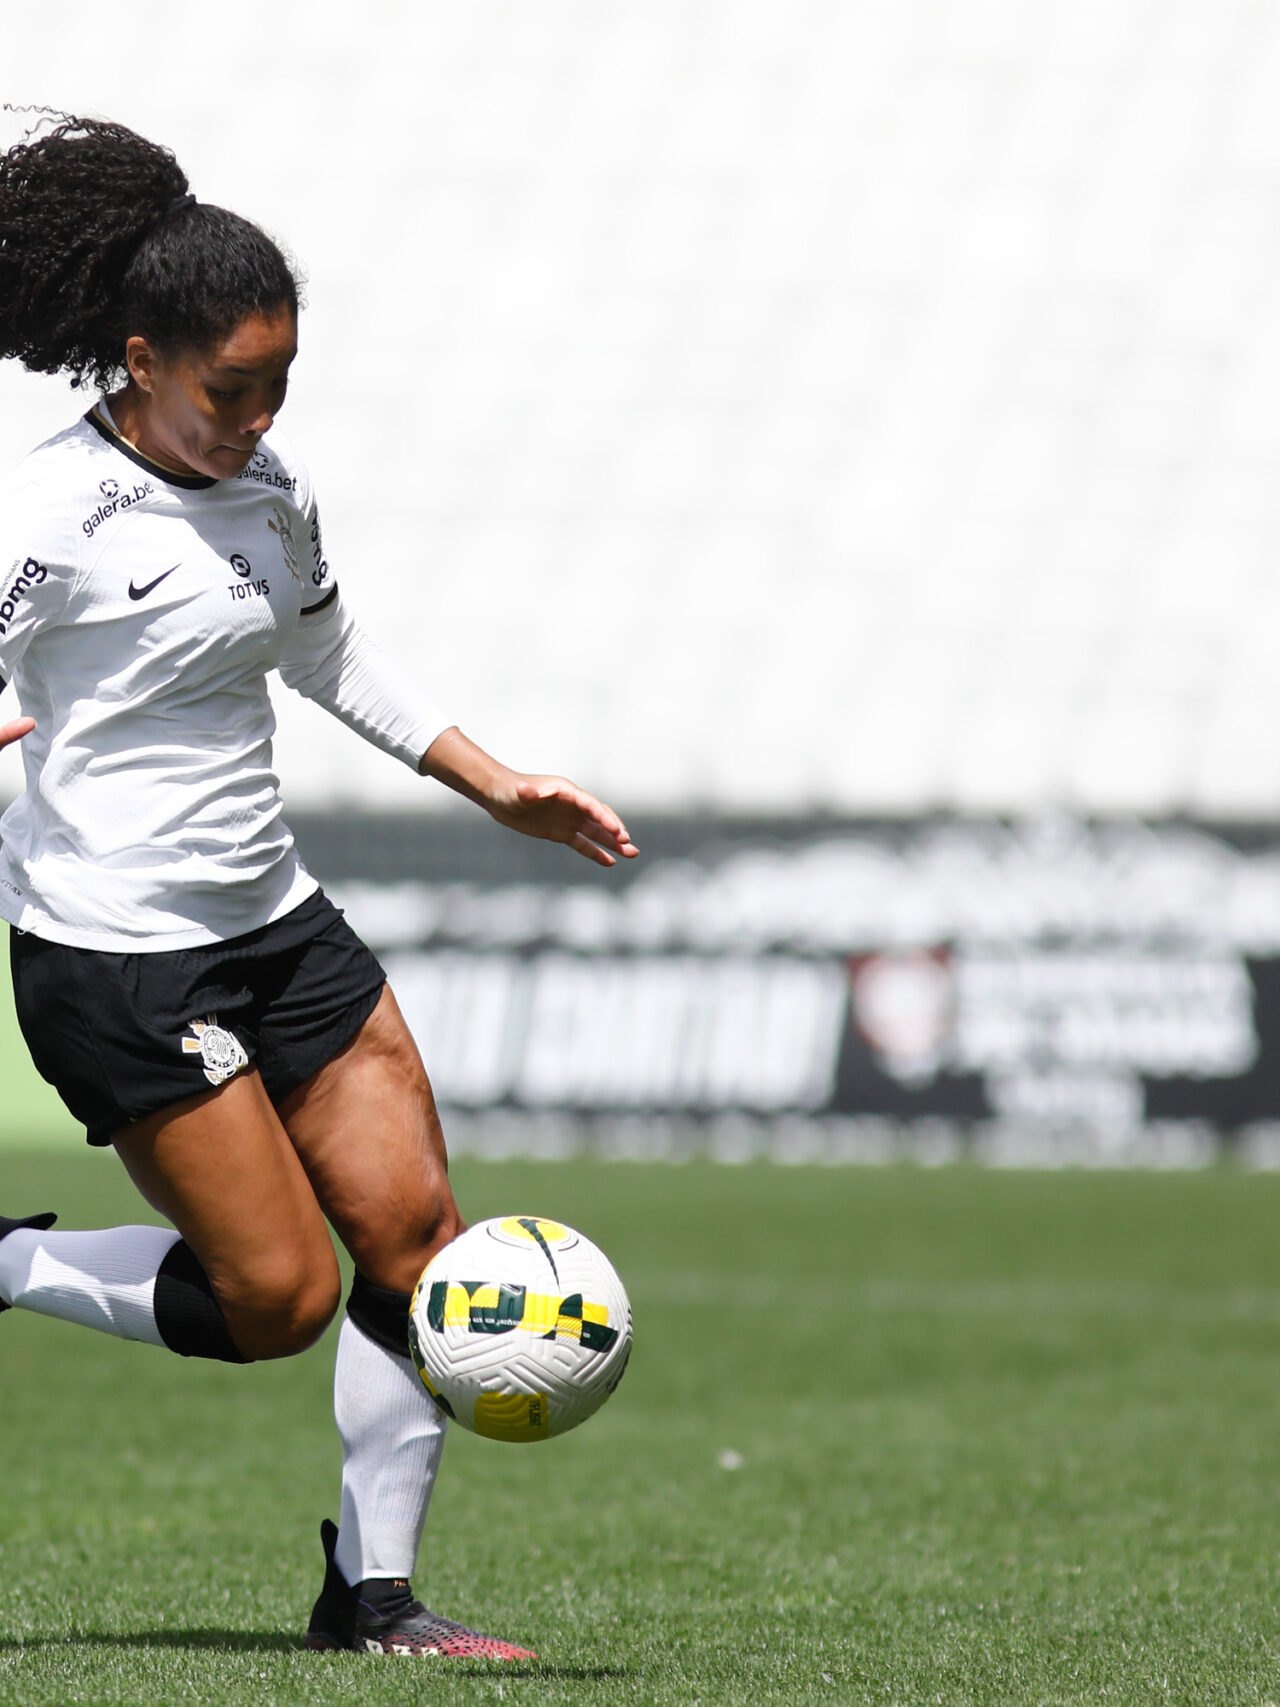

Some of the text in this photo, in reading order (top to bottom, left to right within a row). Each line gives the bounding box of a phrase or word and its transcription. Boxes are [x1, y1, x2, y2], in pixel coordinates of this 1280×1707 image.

[236, 466, 297, 491] alera.bet
[82, 482, 155, 538] galera.be
[227, 579, 270, 601] TOTVS
